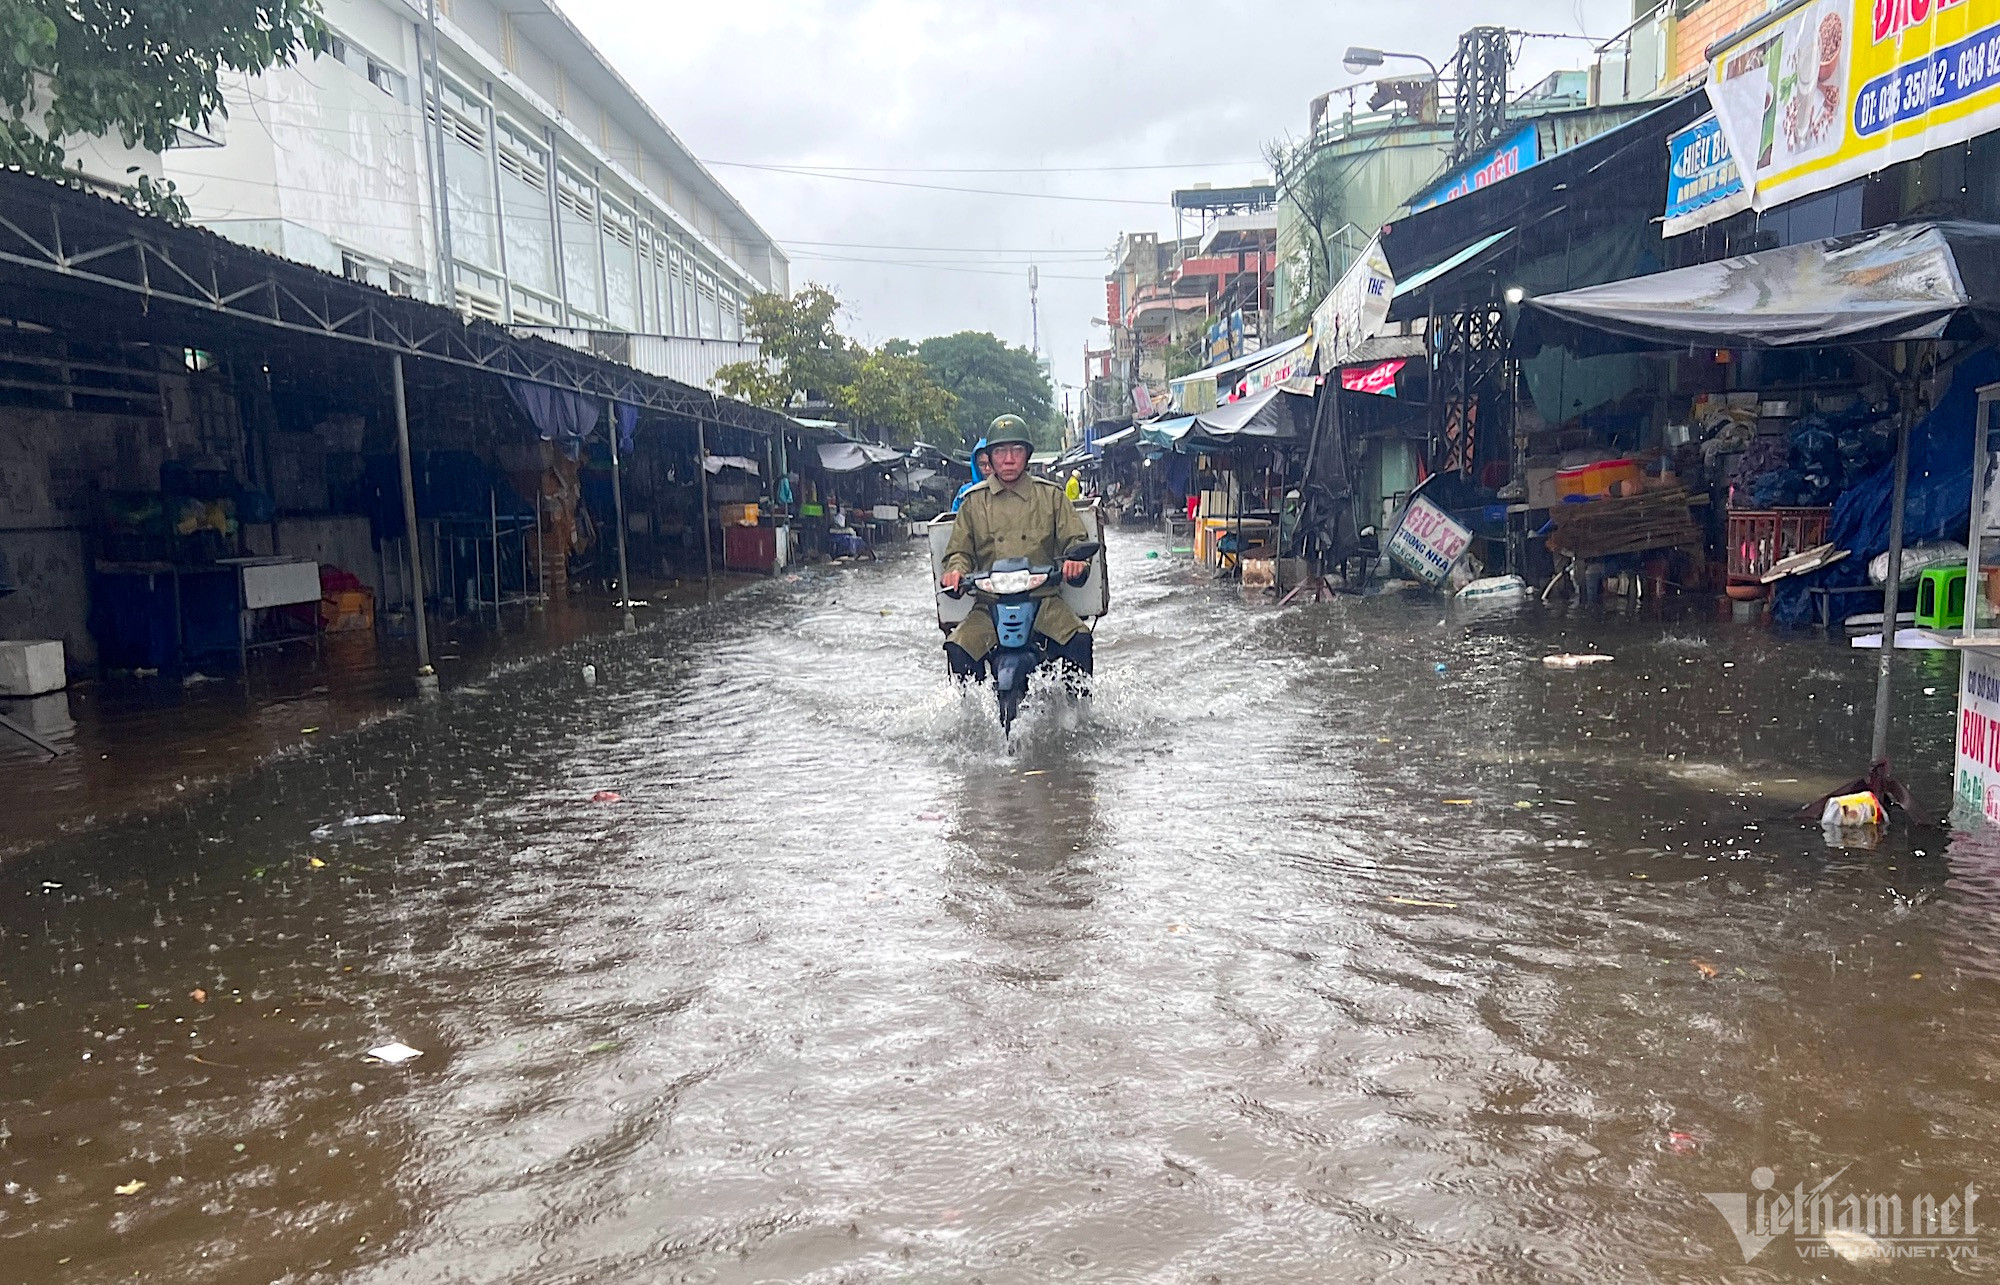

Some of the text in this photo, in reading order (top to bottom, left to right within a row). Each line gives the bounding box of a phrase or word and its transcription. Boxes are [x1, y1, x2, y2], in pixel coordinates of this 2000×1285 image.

[1399, 528, 1450, 571] TRONG NHÀ
[1405, 506, 1466, 560] GIỮ XE
[1962, 702, 1987, 764] BÚN
